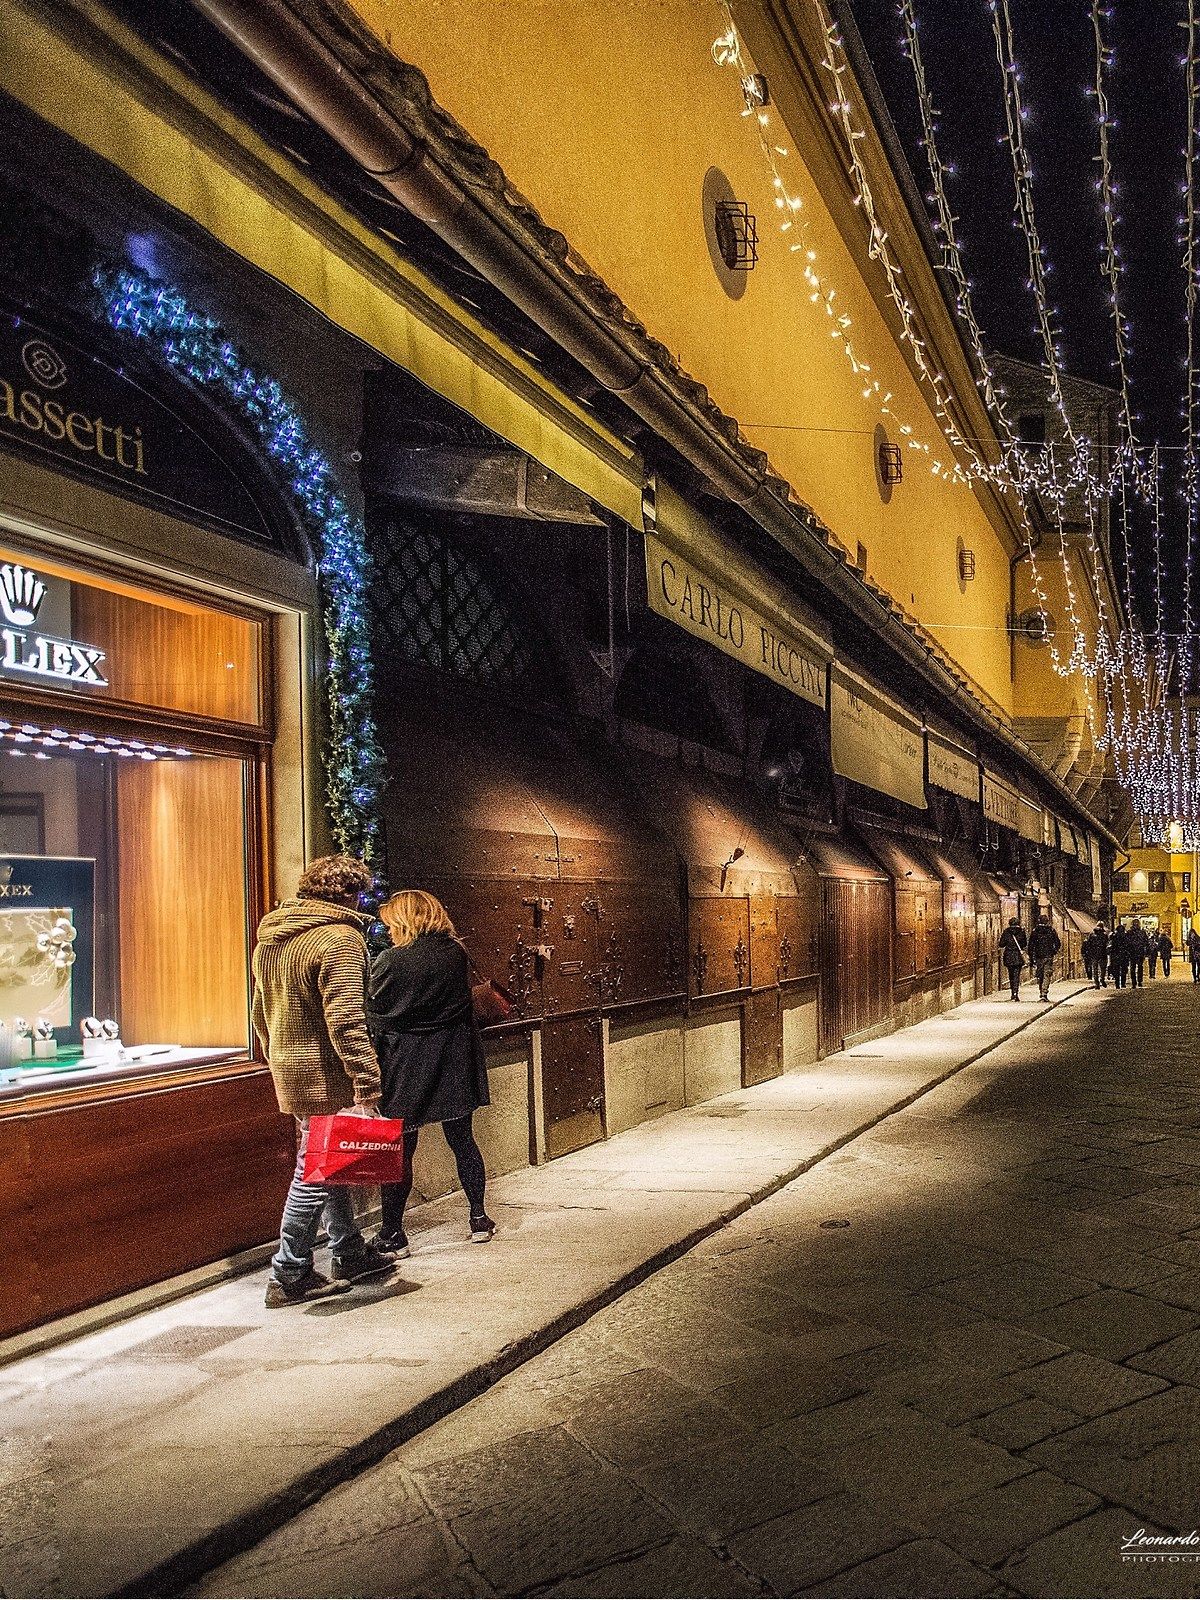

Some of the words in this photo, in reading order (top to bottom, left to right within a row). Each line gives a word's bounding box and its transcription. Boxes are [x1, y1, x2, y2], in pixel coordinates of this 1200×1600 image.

[0, 629, 109, 687] LEX
[660, 559, 744, 649] CARLO
[759, 627, 824, 698] PICCINI
